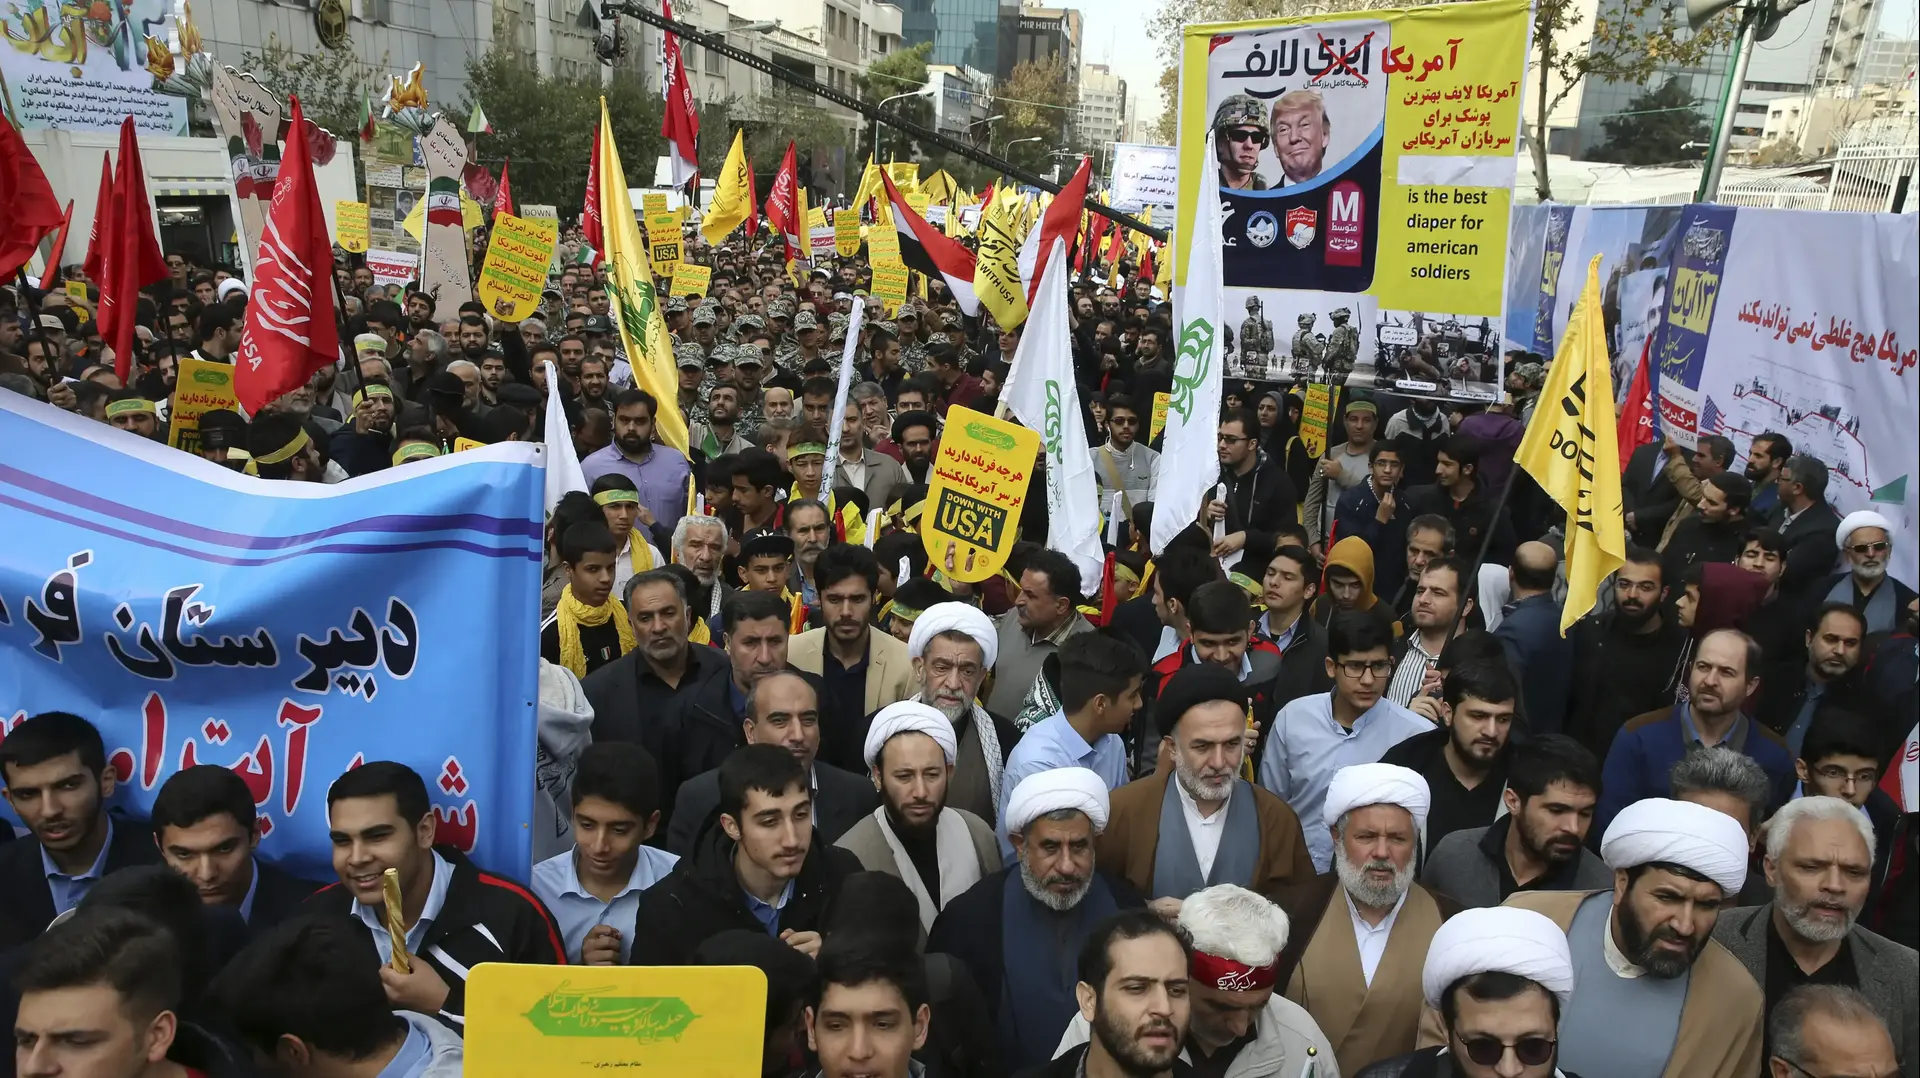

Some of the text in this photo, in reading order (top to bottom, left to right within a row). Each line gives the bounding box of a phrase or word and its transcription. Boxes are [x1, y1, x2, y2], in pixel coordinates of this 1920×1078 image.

[1035, 21, 1061, 31] HOTEL
[1221, 38, 1299, 79] لایف
[1382, 38, 1464, 82] آمریکا
[1403, 81, 1519, 106] آمریکا لایف بهترین
[1423, 107, 1491, 128] پوشک برای
[1402, 129, 1511, 150] سربازان آمریکایی
[1331, 190, 1360, 222] M
[1408, 188, 1488, 205] is the best
[524, 209, 551, 217] DOWN
[1407, 213, 1484, 232] diaper for
[1331, 221, 1358, 234] متوسط
[655, 248, 678, 261] USA
[1407, 239, 1479, 256] american
[1410, 263, 1471, 281] soldiers
[980, 262, 1001, 288] WITH
[999, 285, 1015, 306] USA
[1738, 299, 1918, 376] مریکا هیچ غلطی نمی تواند بکند
[241, 329, 264, 373] USA
[944, 446, 1023, 483] هرچه فریاد دارید
[935, 466, 1022, 508] بر سر آمریکا بکشید
[946, 492, 1002, 520] DOWN WITH
[941, 501, 994, 547] USA
[593, 1060, 613, 1069] رهبری
